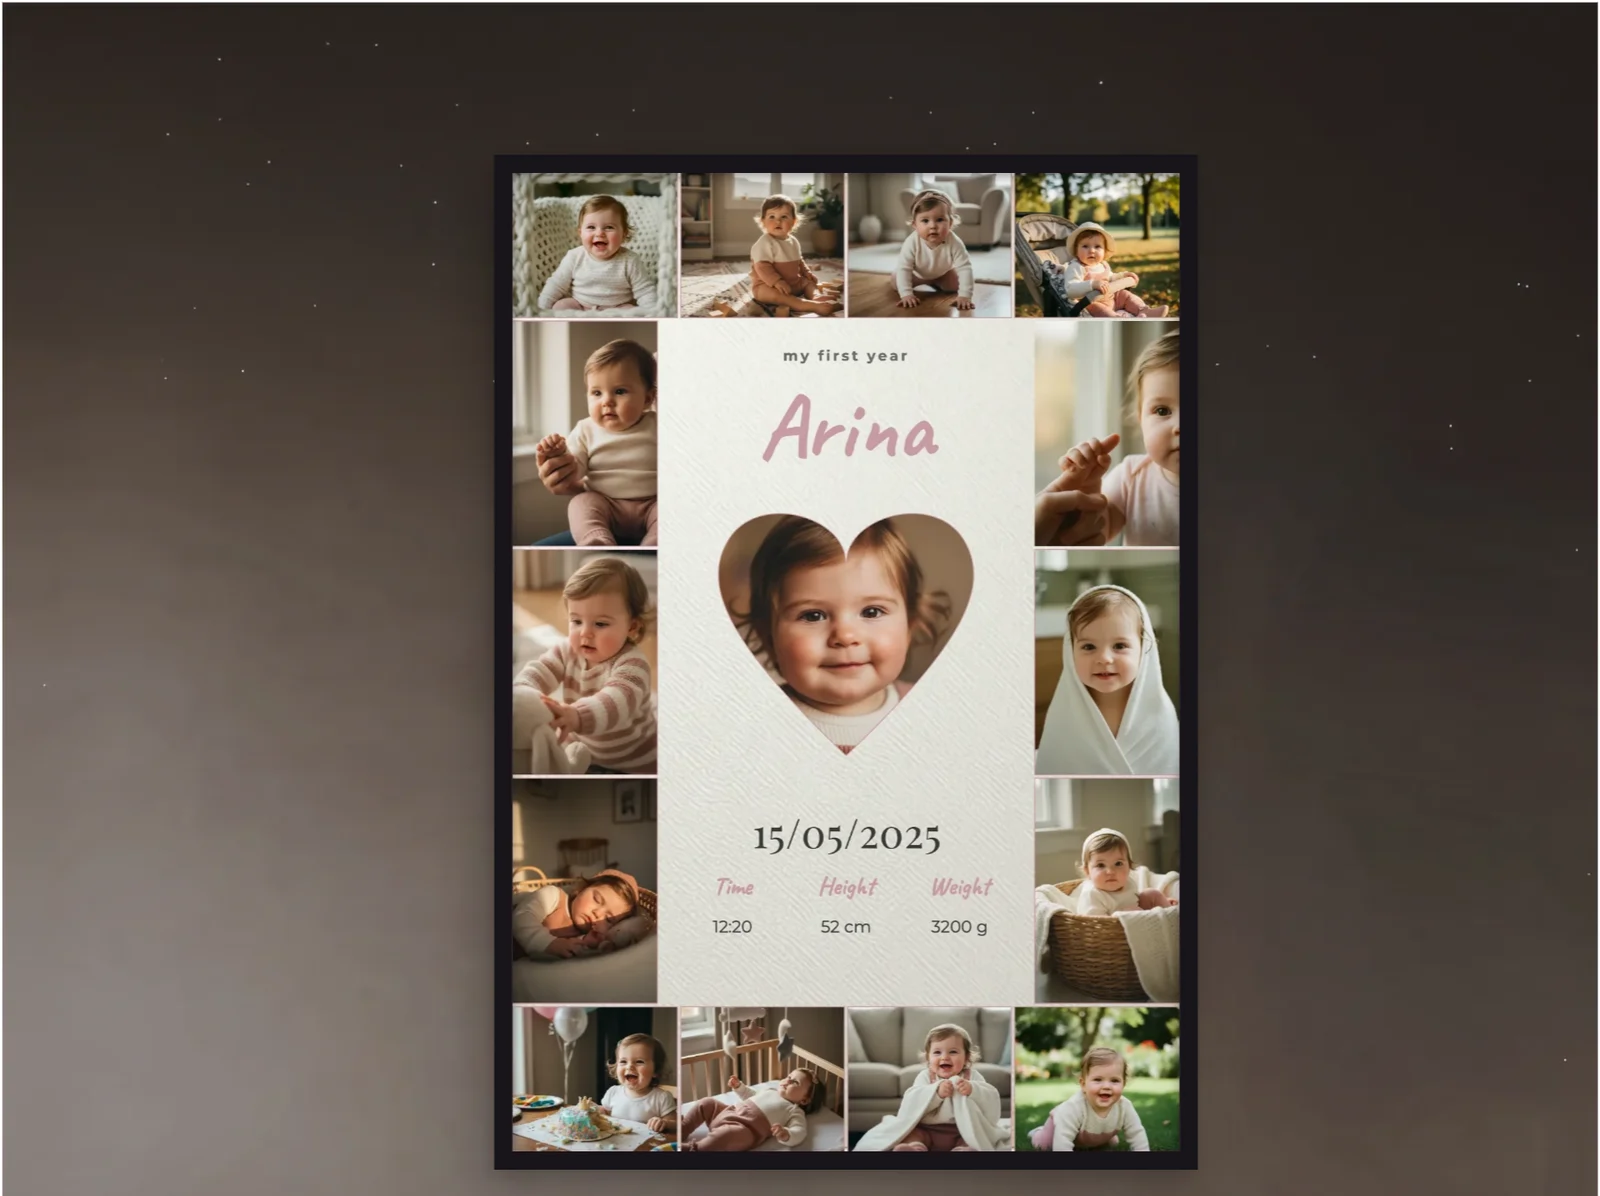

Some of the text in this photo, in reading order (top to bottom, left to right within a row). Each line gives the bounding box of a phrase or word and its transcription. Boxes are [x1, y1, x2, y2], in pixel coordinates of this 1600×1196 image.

[783, 350, 908, 365] my first year
[762, 393, 939, 463] Arina
[754, 818, 941, 855] 15/05/2025
[716, 877, 755, 896] Time
[819, 875, 879, 900] Height
[932, 876, 994, 900] Weight
[712, 919, 753, 934] 12:20
[820, 919, 872, 934] 52 cm
[930, 919, 988, 937] 3200 g
